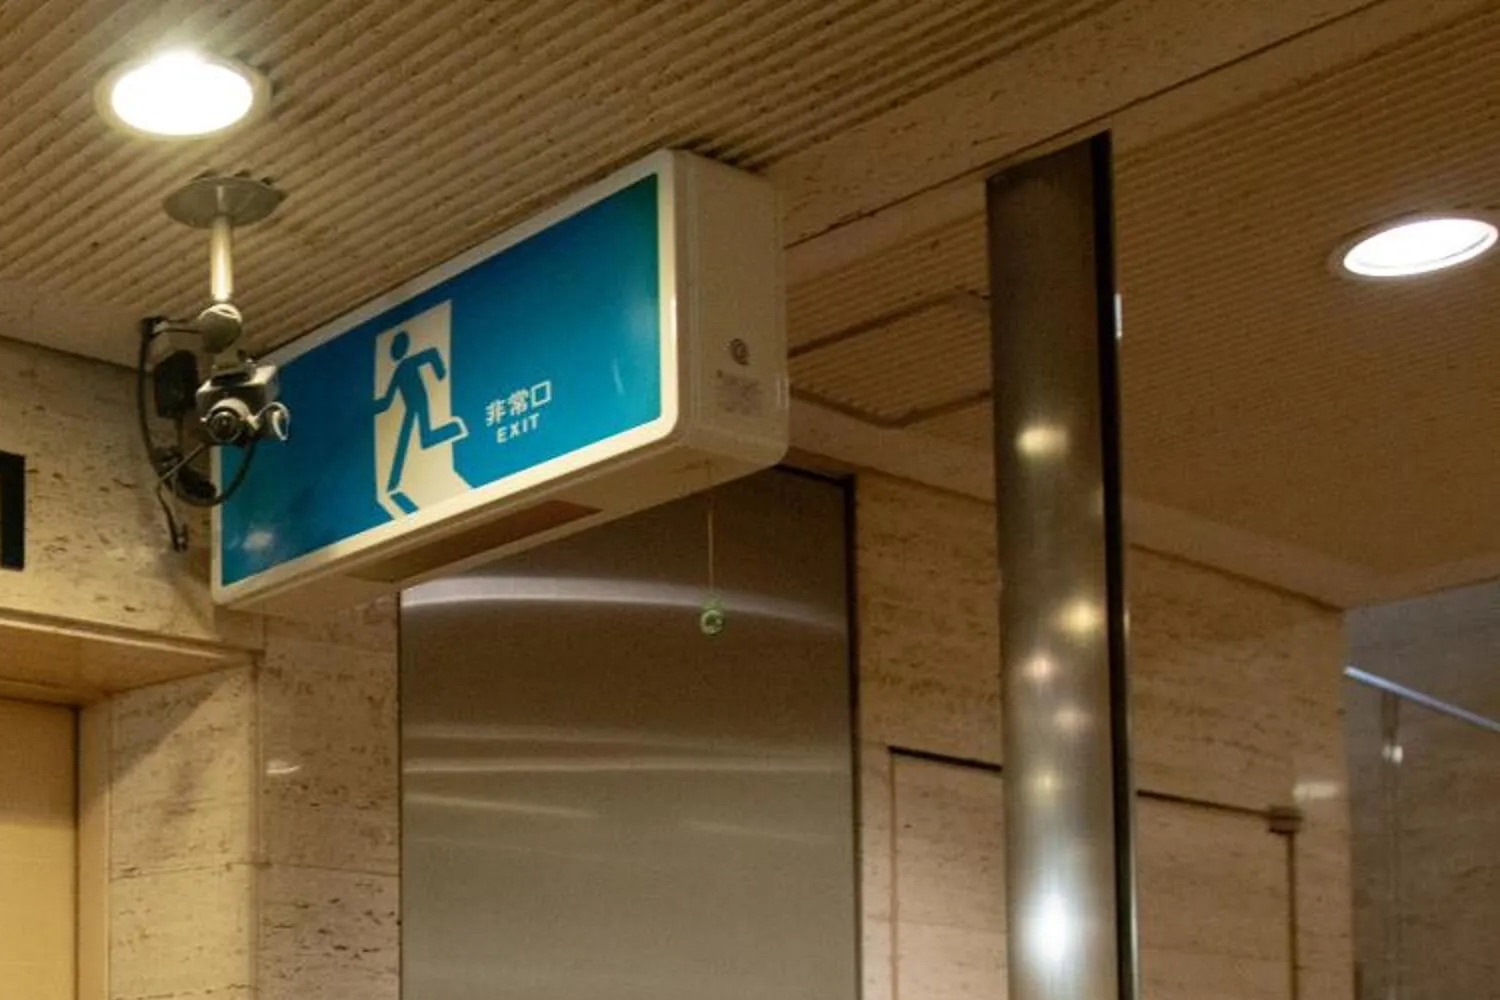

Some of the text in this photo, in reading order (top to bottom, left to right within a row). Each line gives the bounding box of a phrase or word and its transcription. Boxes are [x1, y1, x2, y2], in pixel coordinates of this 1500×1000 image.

[485, 380, 551, 427] 非常口
[496, 413, 540, 444] EXIT
